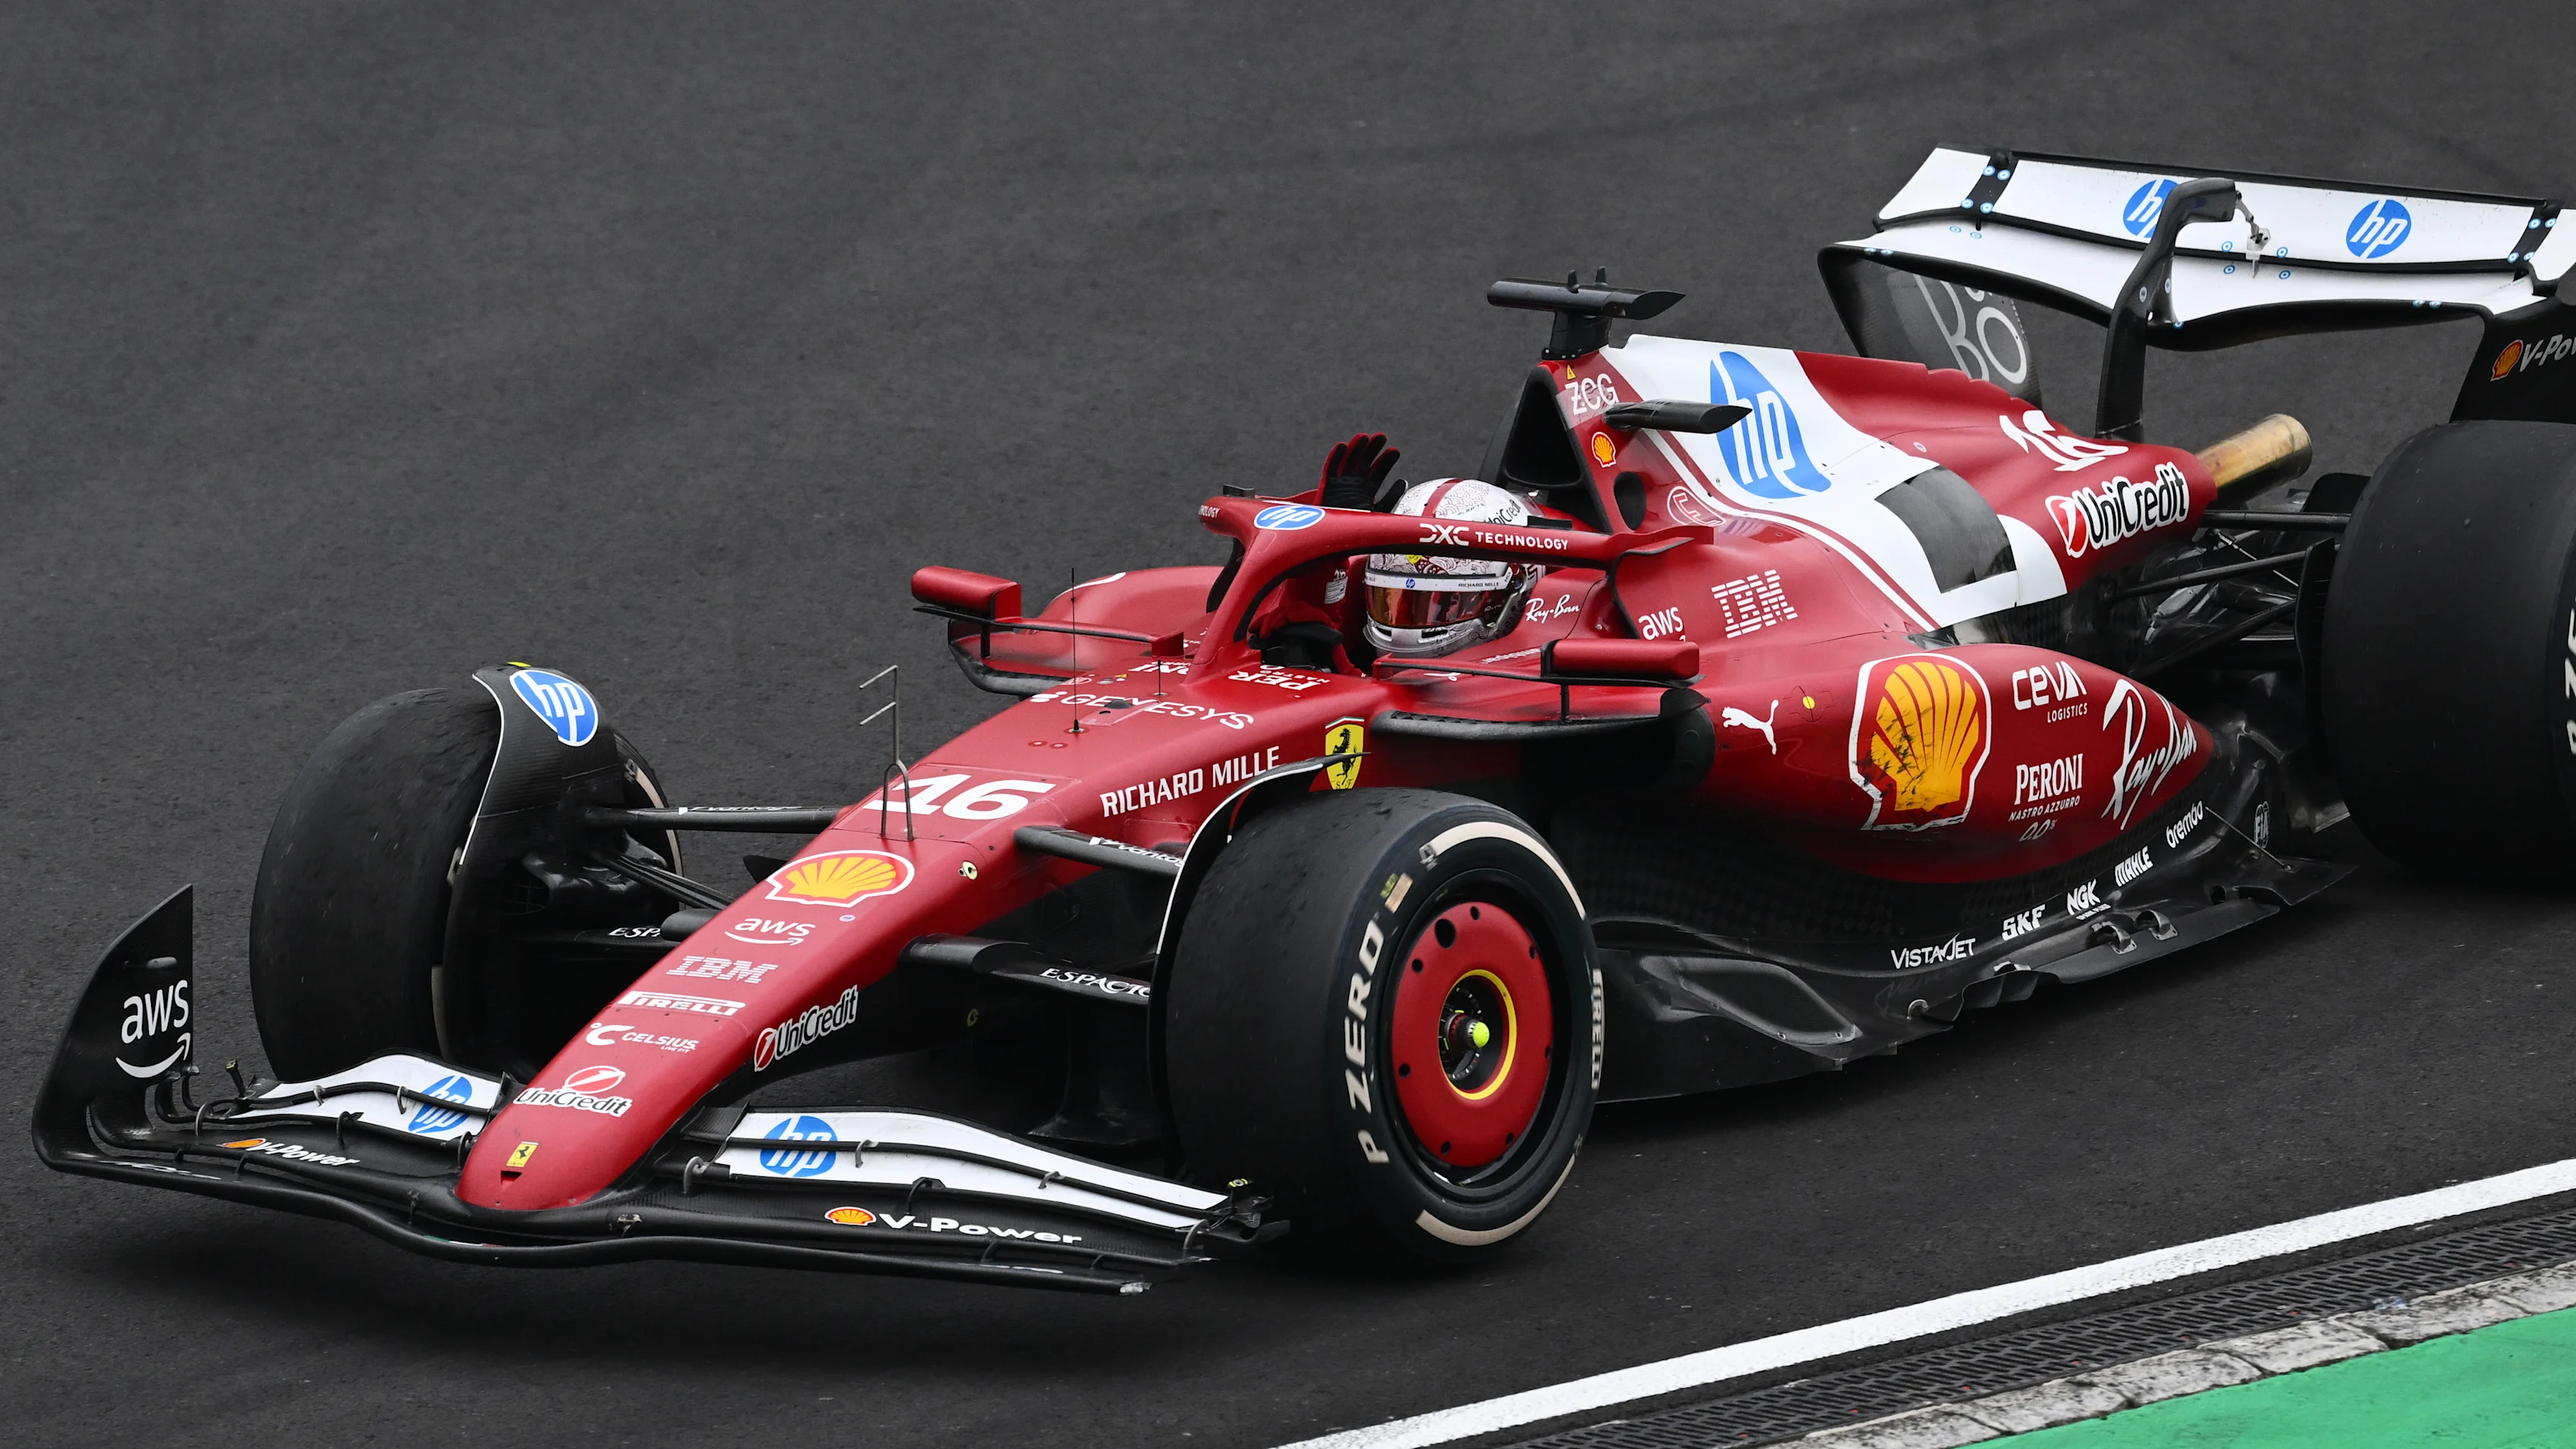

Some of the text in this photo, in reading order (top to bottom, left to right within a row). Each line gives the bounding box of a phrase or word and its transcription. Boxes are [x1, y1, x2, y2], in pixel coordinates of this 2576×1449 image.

[2350, 200, 2408, 258] hp
[2520, 334, 2576, 372] V-Po
[1714, 352, 1817, 497] hp
[1999, 410, 2129, 472] 16
[1258, 506, 1321, 529] hp
[2076, 465, 2187, 545] UniCredit
[1419, 523, 1568, 550] DXC TECHNOLOGY
[1525, 594, 1580, 623] Ray-Ban
[1638, 607, 1684, 640] aws
[1711, 570, 1798, 639] IBM
[515, 670, 594, 745] hp
[2047, 702, 2088, 723] LOGISTICS
[862, 773, 1056, 820] 16
[1100, 746, 1280, 817] RICHARD MILLE
[2014, 753, 2083, 805] PERONI
[2008, 795, 2081, 822] NASTRO AZZURRO
[2166, 800, 2203, 848] brembo
[2114, 845, 2153, 887] MAHLE
[2066, 879, 2101, 915] NGK
[734, 917, 816, 937] aws
[2001, 904, 2045, 941] SKF
[666, 955, 778, 983] IBM
[122, 979, 189, 1044] aws
[617, 991, 746, 1016] PIRELLI
[775, 987, 858, 1059] UniCredit
[1344, 919, 1384, 1114] ZERO
[515, 1088, 631, 1116] UniCredit
[248, 1140, 360, 1168] V-Power
[763, 1116, 836, 1178] hp
[879, 1214, 1082, 1245] V-Power
